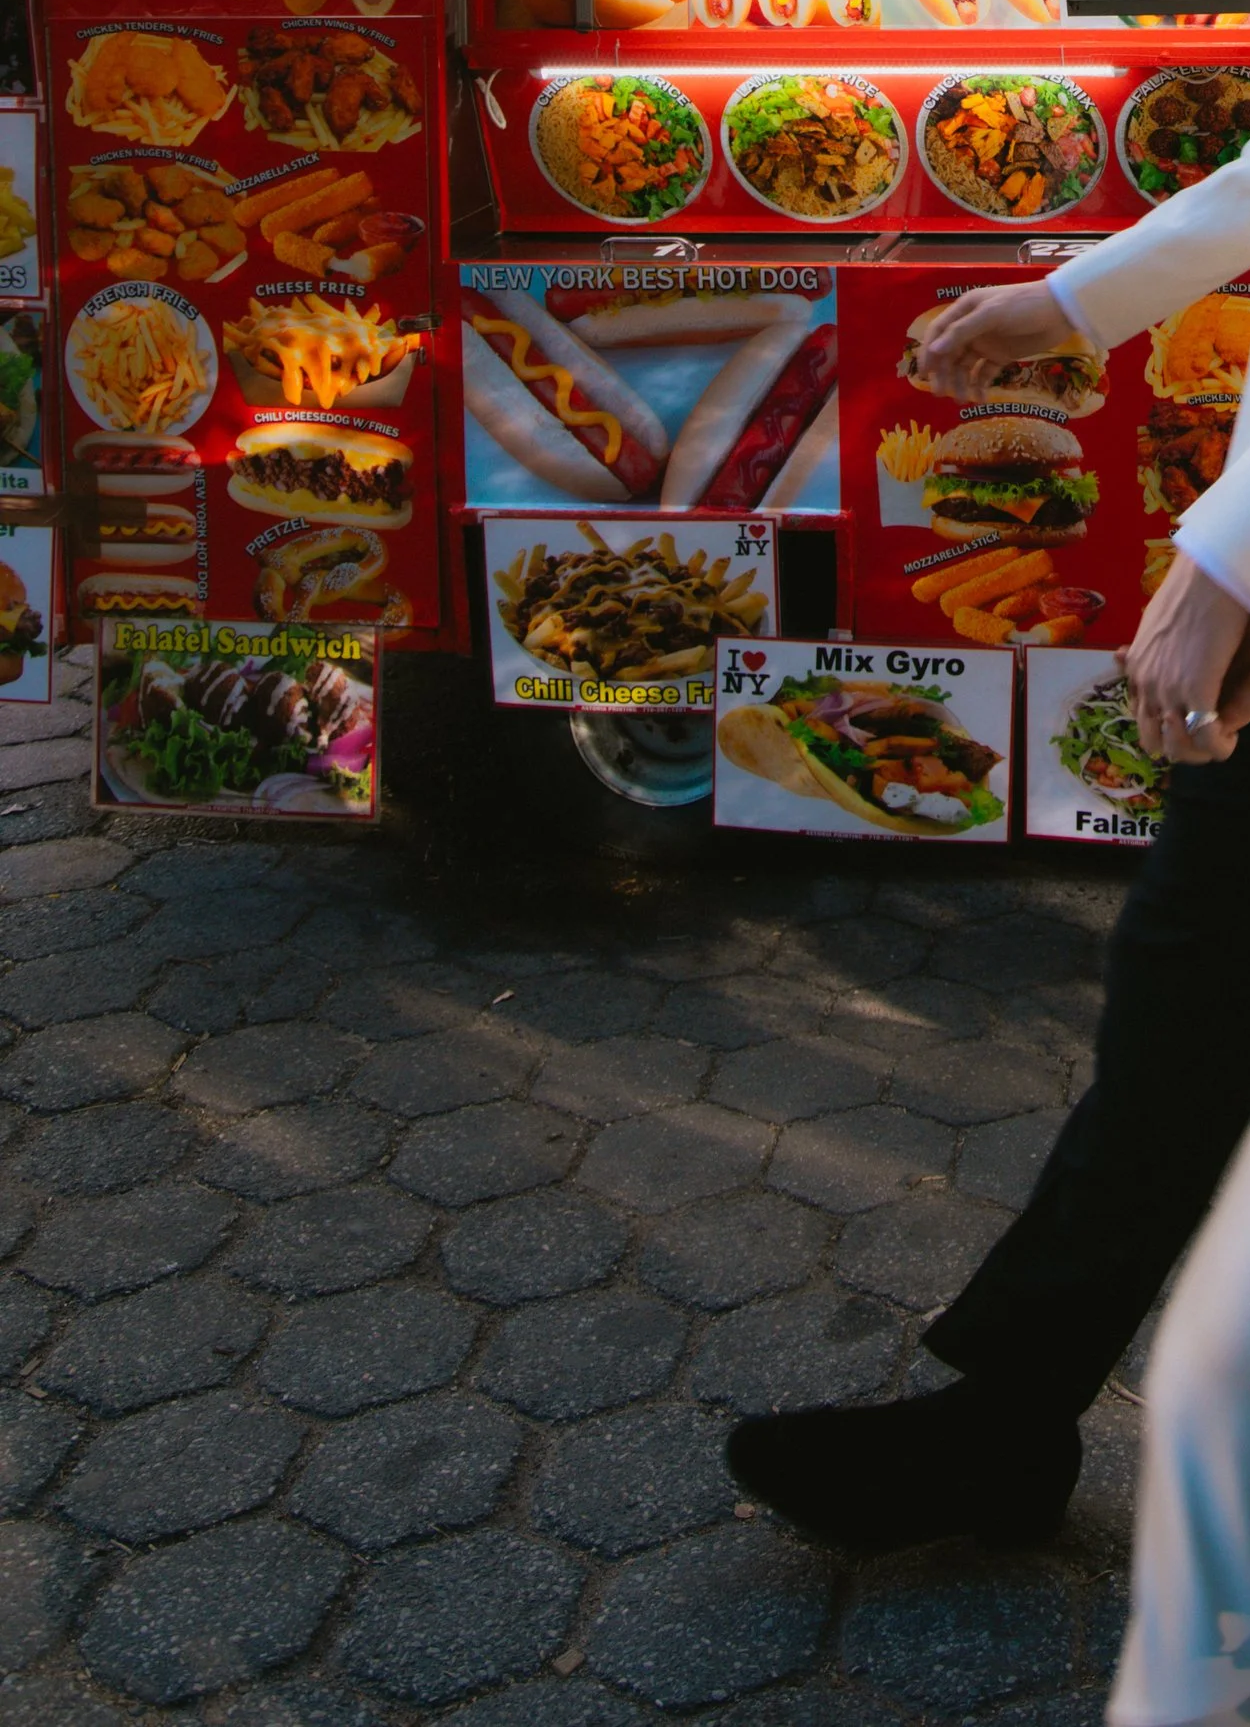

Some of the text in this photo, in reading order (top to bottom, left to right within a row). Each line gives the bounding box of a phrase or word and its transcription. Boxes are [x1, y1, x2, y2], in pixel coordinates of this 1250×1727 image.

[77, 21, 224, 45] CHICKEN TENDERS W/FRIES
[282, 20, 396, 48] CHICKEN WINGS W/FRIES
[646, 75, 690, 106] RICE
[838, 74, 881, 98] RICE
[1067, 86, 1096, 112] MIX
[90, 148, 217, 172] CHICKEN NUGETS W/FRIES
[224, 152, 320, 197] MOZZARELLA STICK
[256, 281, 365, 297] CHEESE FRIES
[471, 267, 820, 290] NEW YORK BEST HOT DOG
[84, 283, 200, 320] FRENCH FRIES
[1187, 393, 1233, 406] CHICKEN
[254, 412, 400, 438] CHILI CHEESEDOG W/FRIES
[959, 402, 1069, 425] CHEESEBURGER
[195, 469, 208, 601] NEW YORK HOT DOG
[246, 517, 310, 557] PRETZEL
[738, 524, 747, 539] I
[735, 540, 770, 556] NY
[903, 530, 1001, 575] MOZZARELLA STICK
[113, 622, 362, 661] Falafel Sandwich
[727, 649, 740, 672] I
[815, 647, 965, 681] Mix Gyro
[515, 676, 573, 702] Chili
[580, 680, 680, 705] Cheese
[722, 672, 771, 695] NY
